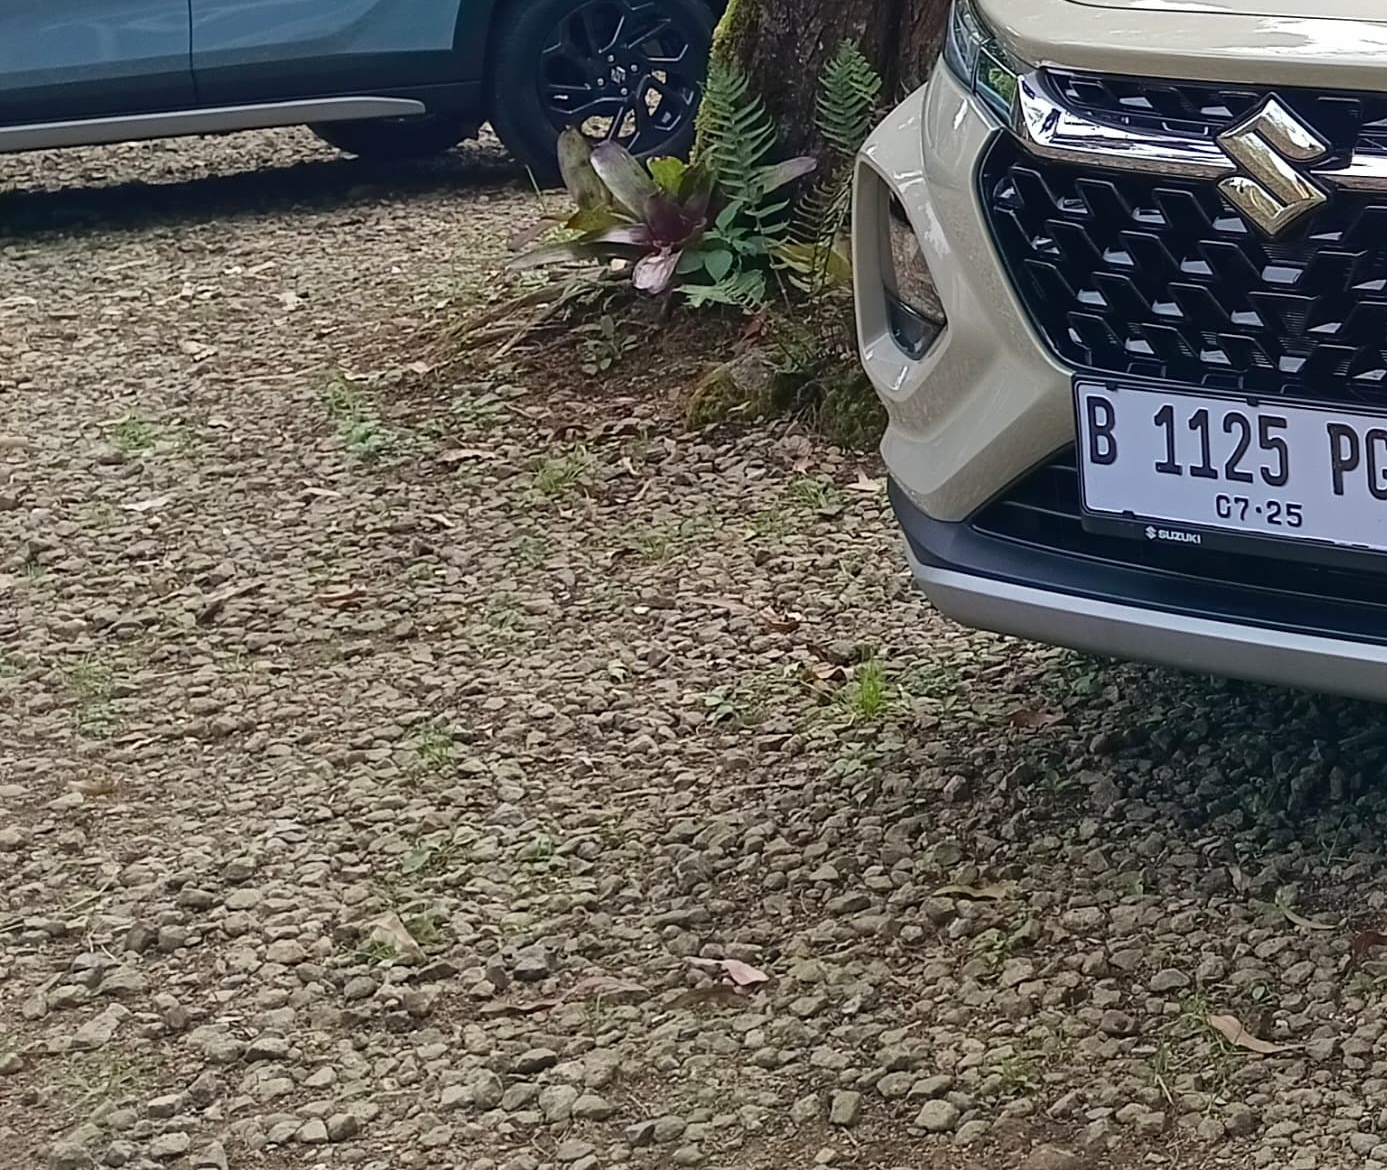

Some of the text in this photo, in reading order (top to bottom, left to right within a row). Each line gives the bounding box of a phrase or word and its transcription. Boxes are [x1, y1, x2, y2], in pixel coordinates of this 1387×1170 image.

[1086, 396, 1118, 465] B
[1153, 405, 1289, 486] 1125
[1158, 530, 1201, 544] SUZUKI
